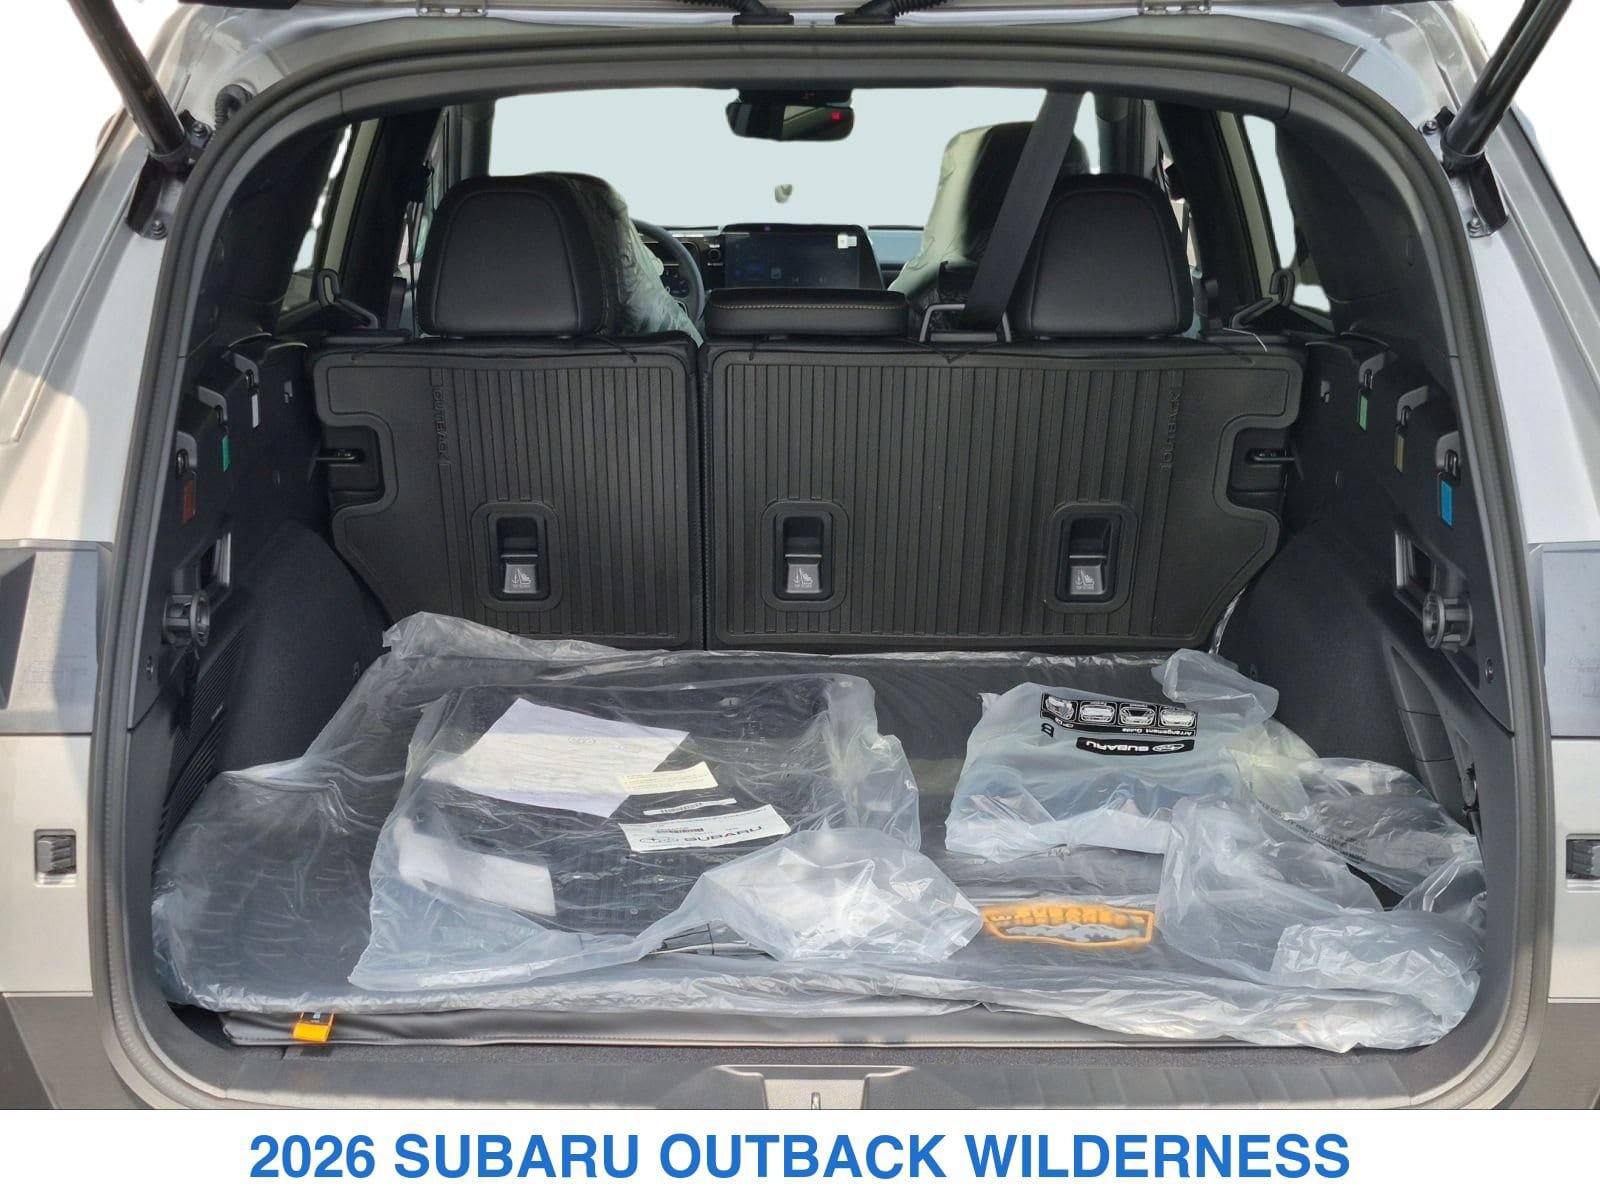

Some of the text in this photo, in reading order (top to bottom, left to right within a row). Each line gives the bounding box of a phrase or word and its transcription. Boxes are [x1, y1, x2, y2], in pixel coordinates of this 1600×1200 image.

[1145, 728, 1193, 736] Arrangement
[1085, 740, 1150, 752] SUBARU
[684, 825, 763, 842] SUBARU
